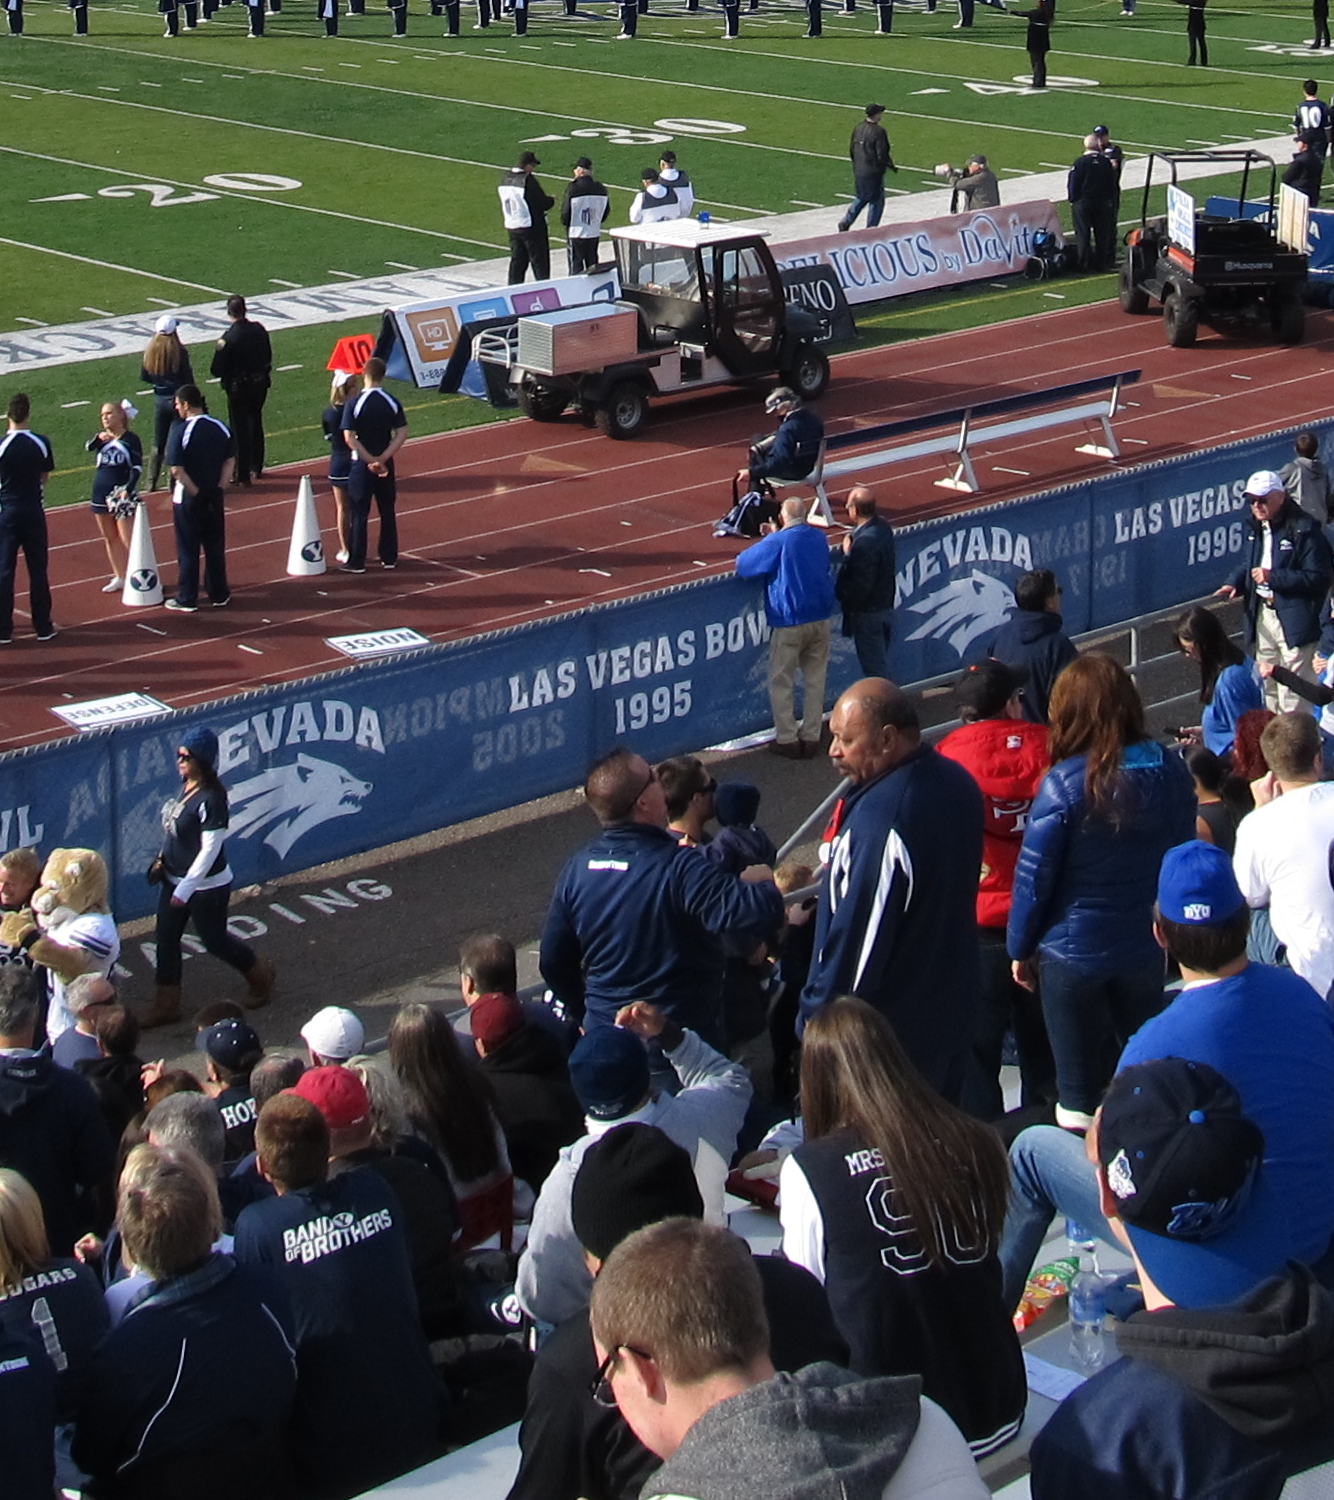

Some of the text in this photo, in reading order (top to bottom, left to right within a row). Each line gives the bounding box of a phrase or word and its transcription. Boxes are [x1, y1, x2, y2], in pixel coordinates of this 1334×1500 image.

[570, 118, 748, 145] 30
[1299, 105, 1322, 129] 10
[96, 172, 303, 208] 20
[942, 251, 961, 273] by
[782, 278, 837, 312] ENO
[426, 326, 444, 338] HD
[348, 337, 372, 367] 10
[101, 449, 125, 466] BYU
[1113, 478, 1246, 546] LAS VEGAS
[1185, 520, 1243, 567] 1996
[894, 525, 1035, 610] NEVADA
[342, 631, 417, 652] NOISE
[507, 602, 769, 714] LAS VEGAS BOW
[67, 697, 149, 723] DEFENSE
[613, 678, 694, 736] 1995
[217, 699, 387, 772] EVADA
[282, 1215, 336, 1250] BAND
[284, 1207, 393, 1265] OF BROTHERS
[866, 1174, 989, 1277] 90
[31, 1296, 69, 1373] 1
